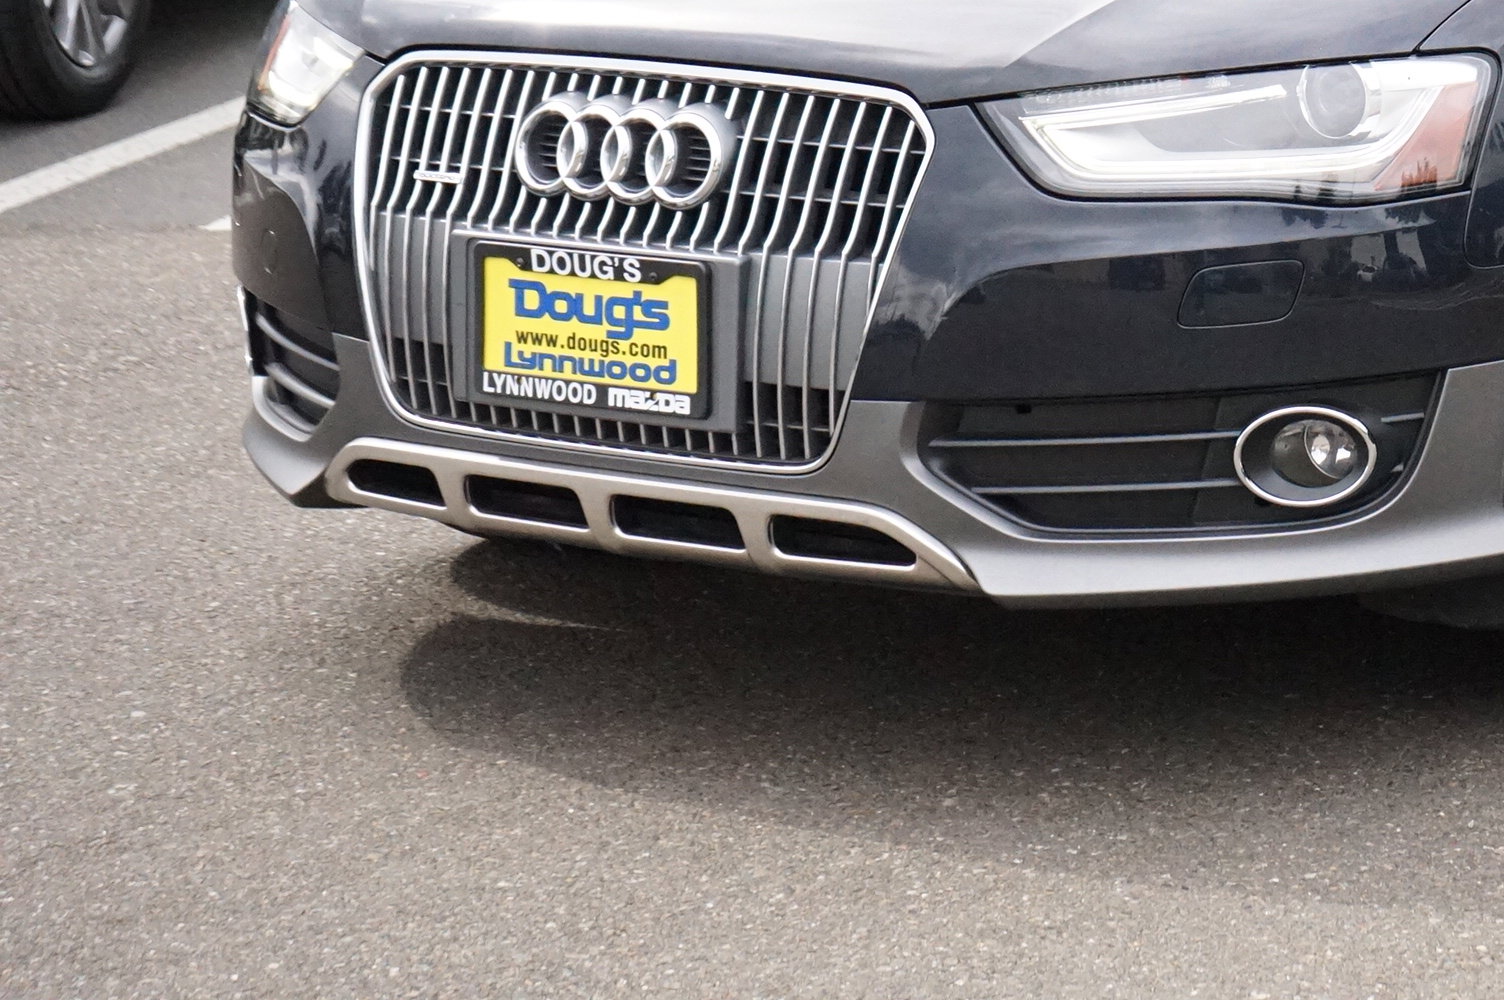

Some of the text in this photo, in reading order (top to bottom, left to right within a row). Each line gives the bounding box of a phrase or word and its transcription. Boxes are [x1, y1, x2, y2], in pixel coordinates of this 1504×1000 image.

[530, 249, 642, 283] DOUG'S
[515, 330, 668, 360] www.dougs.com
[504, 341, 677, 385] Lynnwood
[482, 371, 597, 405] LYNNWOOD
